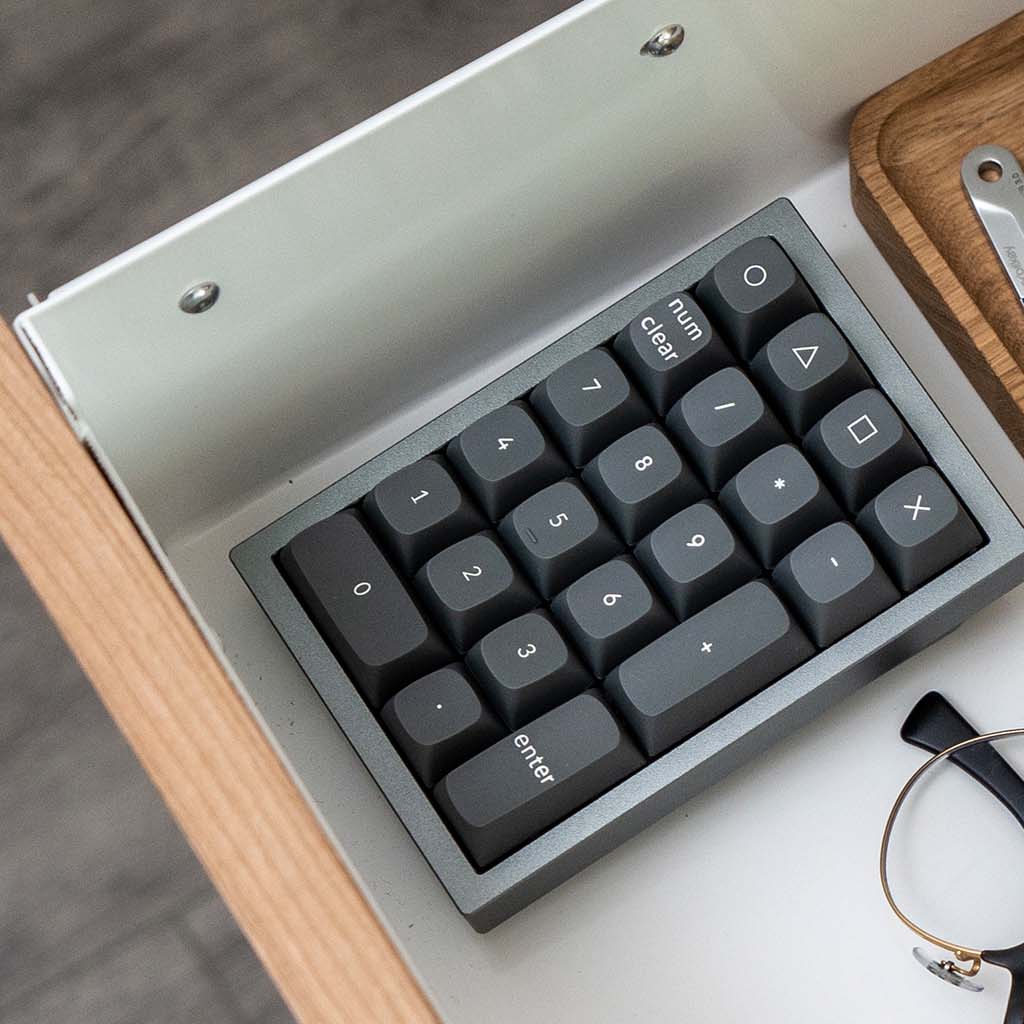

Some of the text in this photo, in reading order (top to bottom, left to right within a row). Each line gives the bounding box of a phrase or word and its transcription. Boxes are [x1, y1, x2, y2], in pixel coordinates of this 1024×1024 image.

[667, 297, 704, 342] num
[640, 316, 680, 361] clear
[581, 377, 602, 391] 7
[497, 437, 515, 451] 4
[634, 455, 654, 472] 8
[410, 489, 429, 505] 1
[548, 511, 569, 528] 5
[685, 533, 706, 548] 9
[461, 565, 482, 583] 2
[352, 582, 373, 596] 0
[602, 593, 623, 607] 6
[517, 643, 537, 659] 3
[700, 641, 713, 653] +
[513, 733, 555, 784] enter
